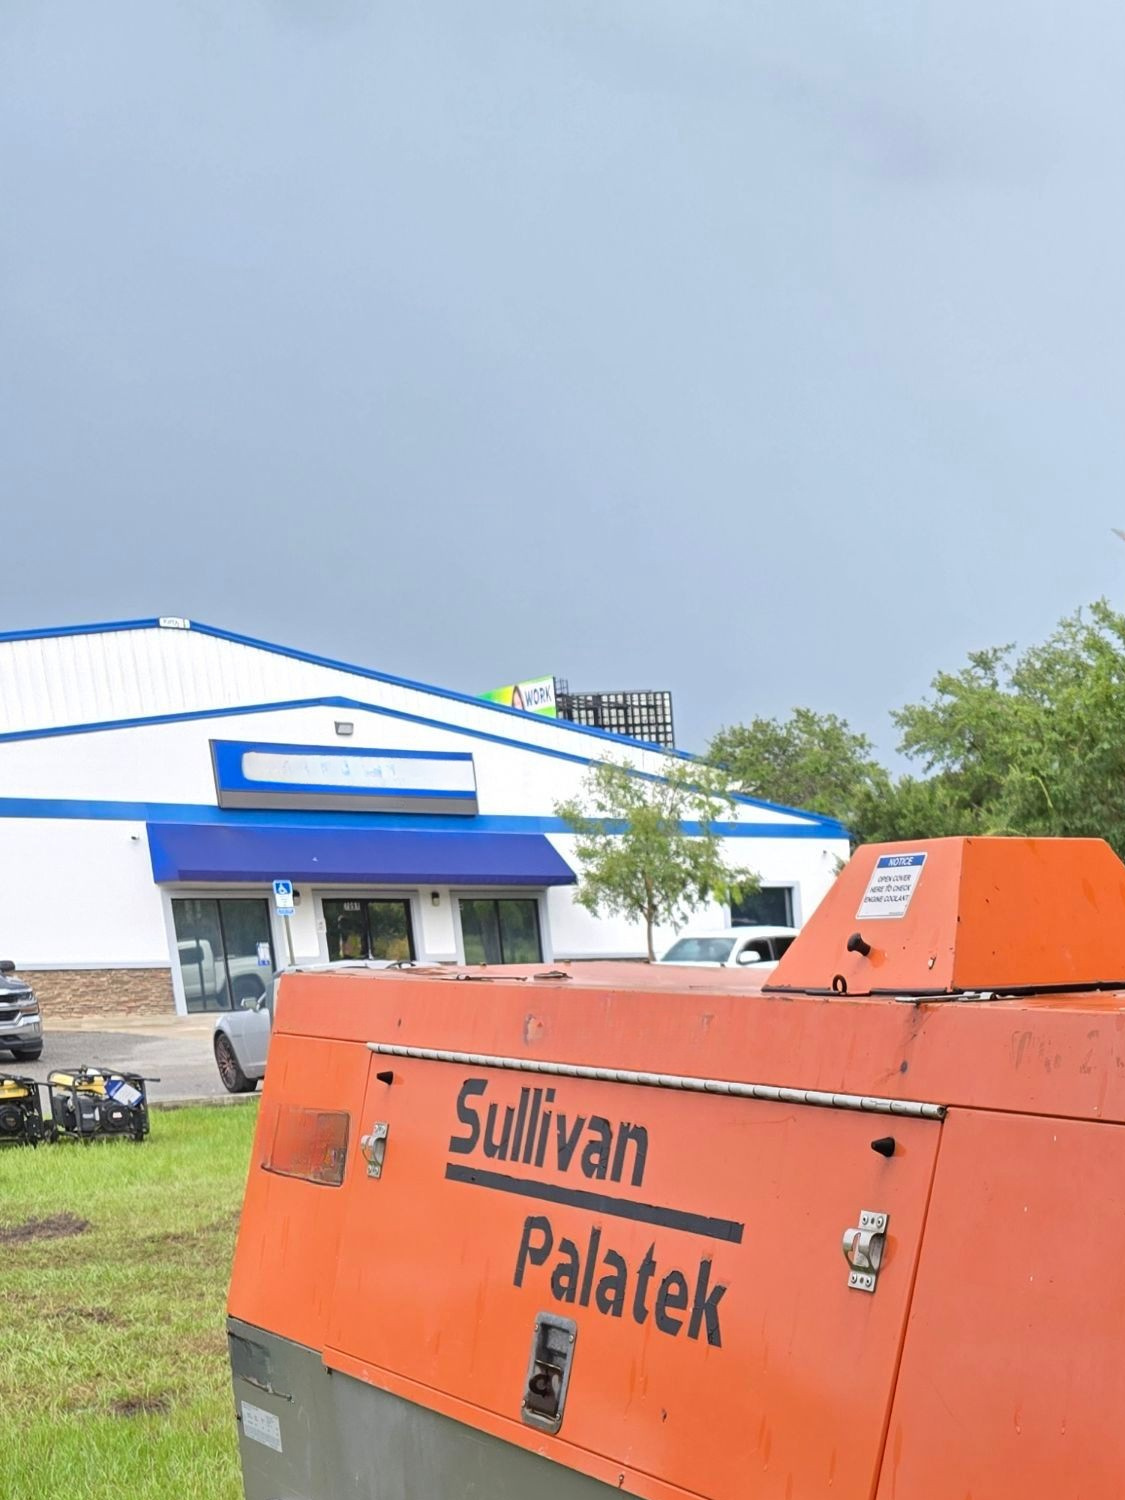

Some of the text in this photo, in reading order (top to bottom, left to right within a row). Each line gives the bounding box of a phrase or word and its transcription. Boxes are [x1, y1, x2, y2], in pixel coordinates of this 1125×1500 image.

[524, 685, 552, 706] WORK
[888, 857, 914, 866] NOTICE
[878, 874, 911, 883] OPEN COVER
[884, 895, 909, 903] COOLANT
[449, 1078, 649, 1187] Sullivan
[513, 1215, 727, 1348] Palatek
